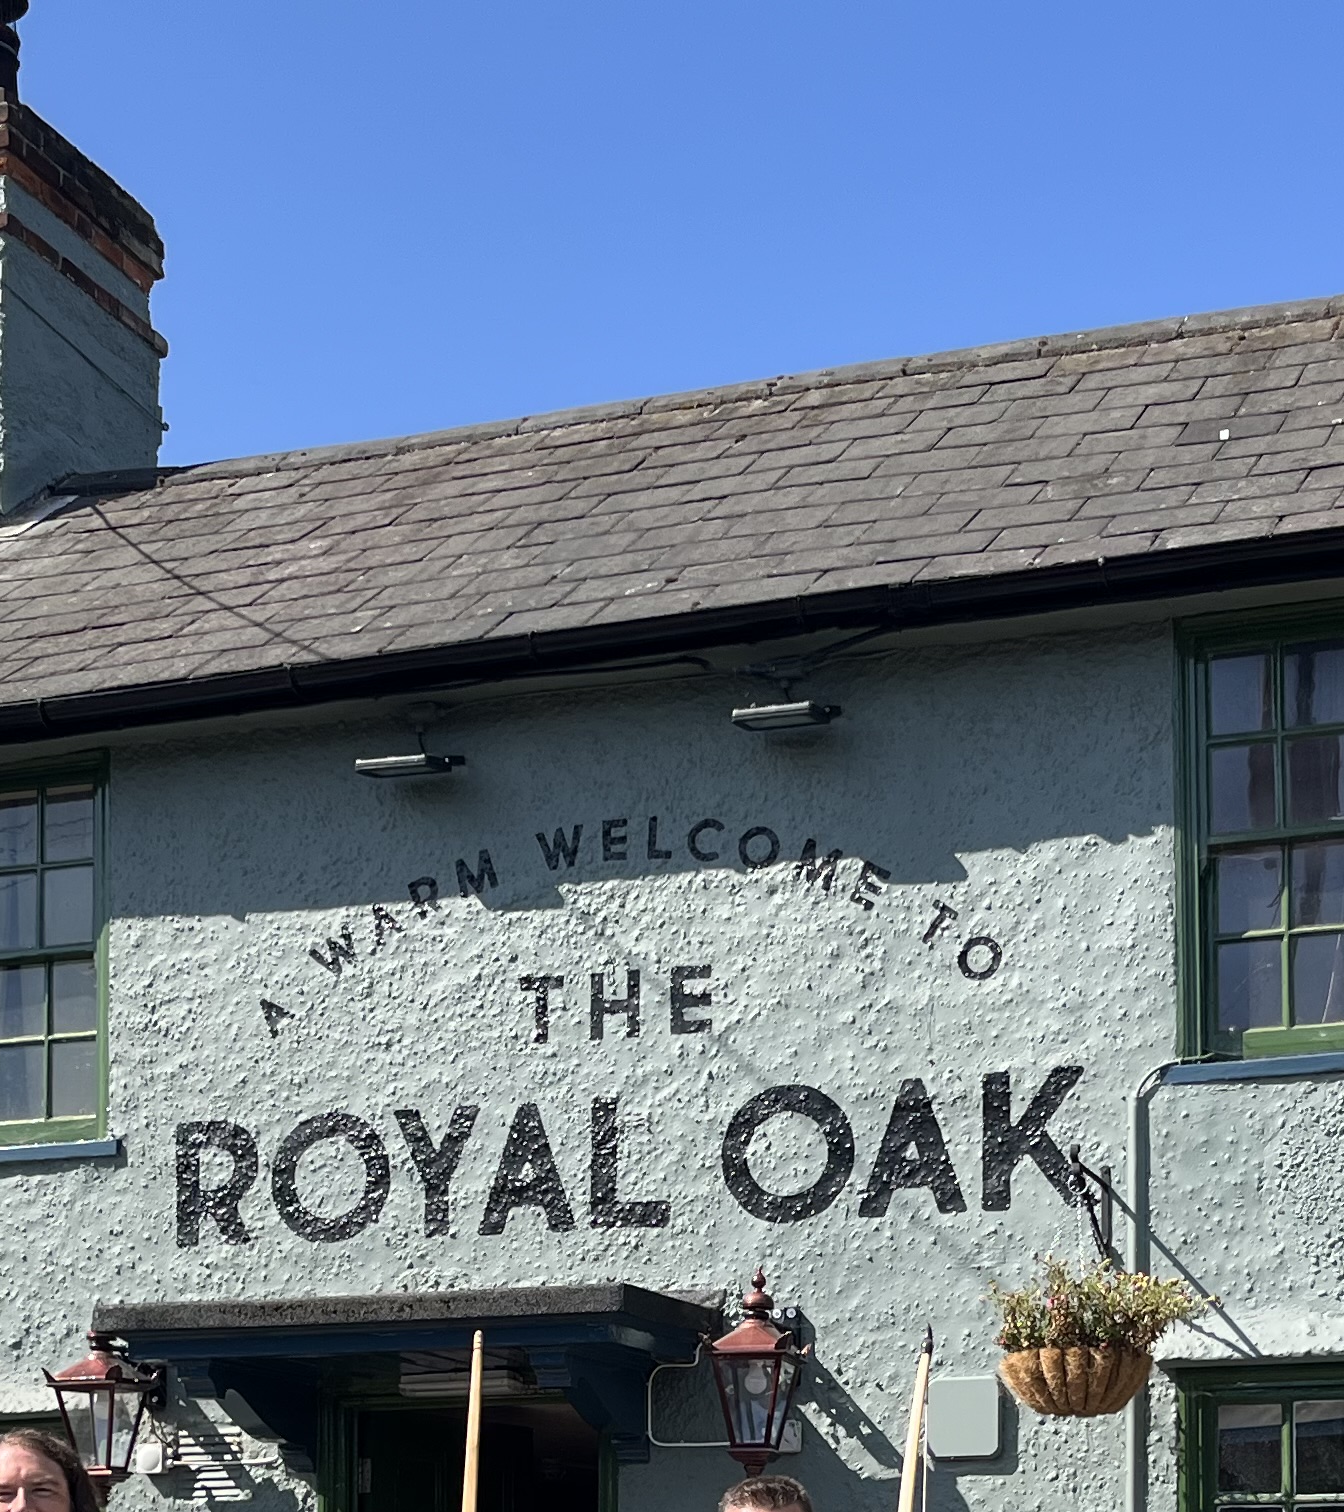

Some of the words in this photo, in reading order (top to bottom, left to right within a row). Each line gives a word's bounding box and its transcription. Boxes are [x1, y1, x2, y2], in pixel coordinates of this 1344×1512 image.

[260, 998, 294, 1038] A
[309, 849, 500, 976] WARM
[536, 816, 891, 910] WELCOME
[920, 899, 1003, 981] TO
[519, 964, 713, 1043] THE
[175, 1096, 670, 1248] ROYAL
[721, 1064, 1086, 1224] OAK
